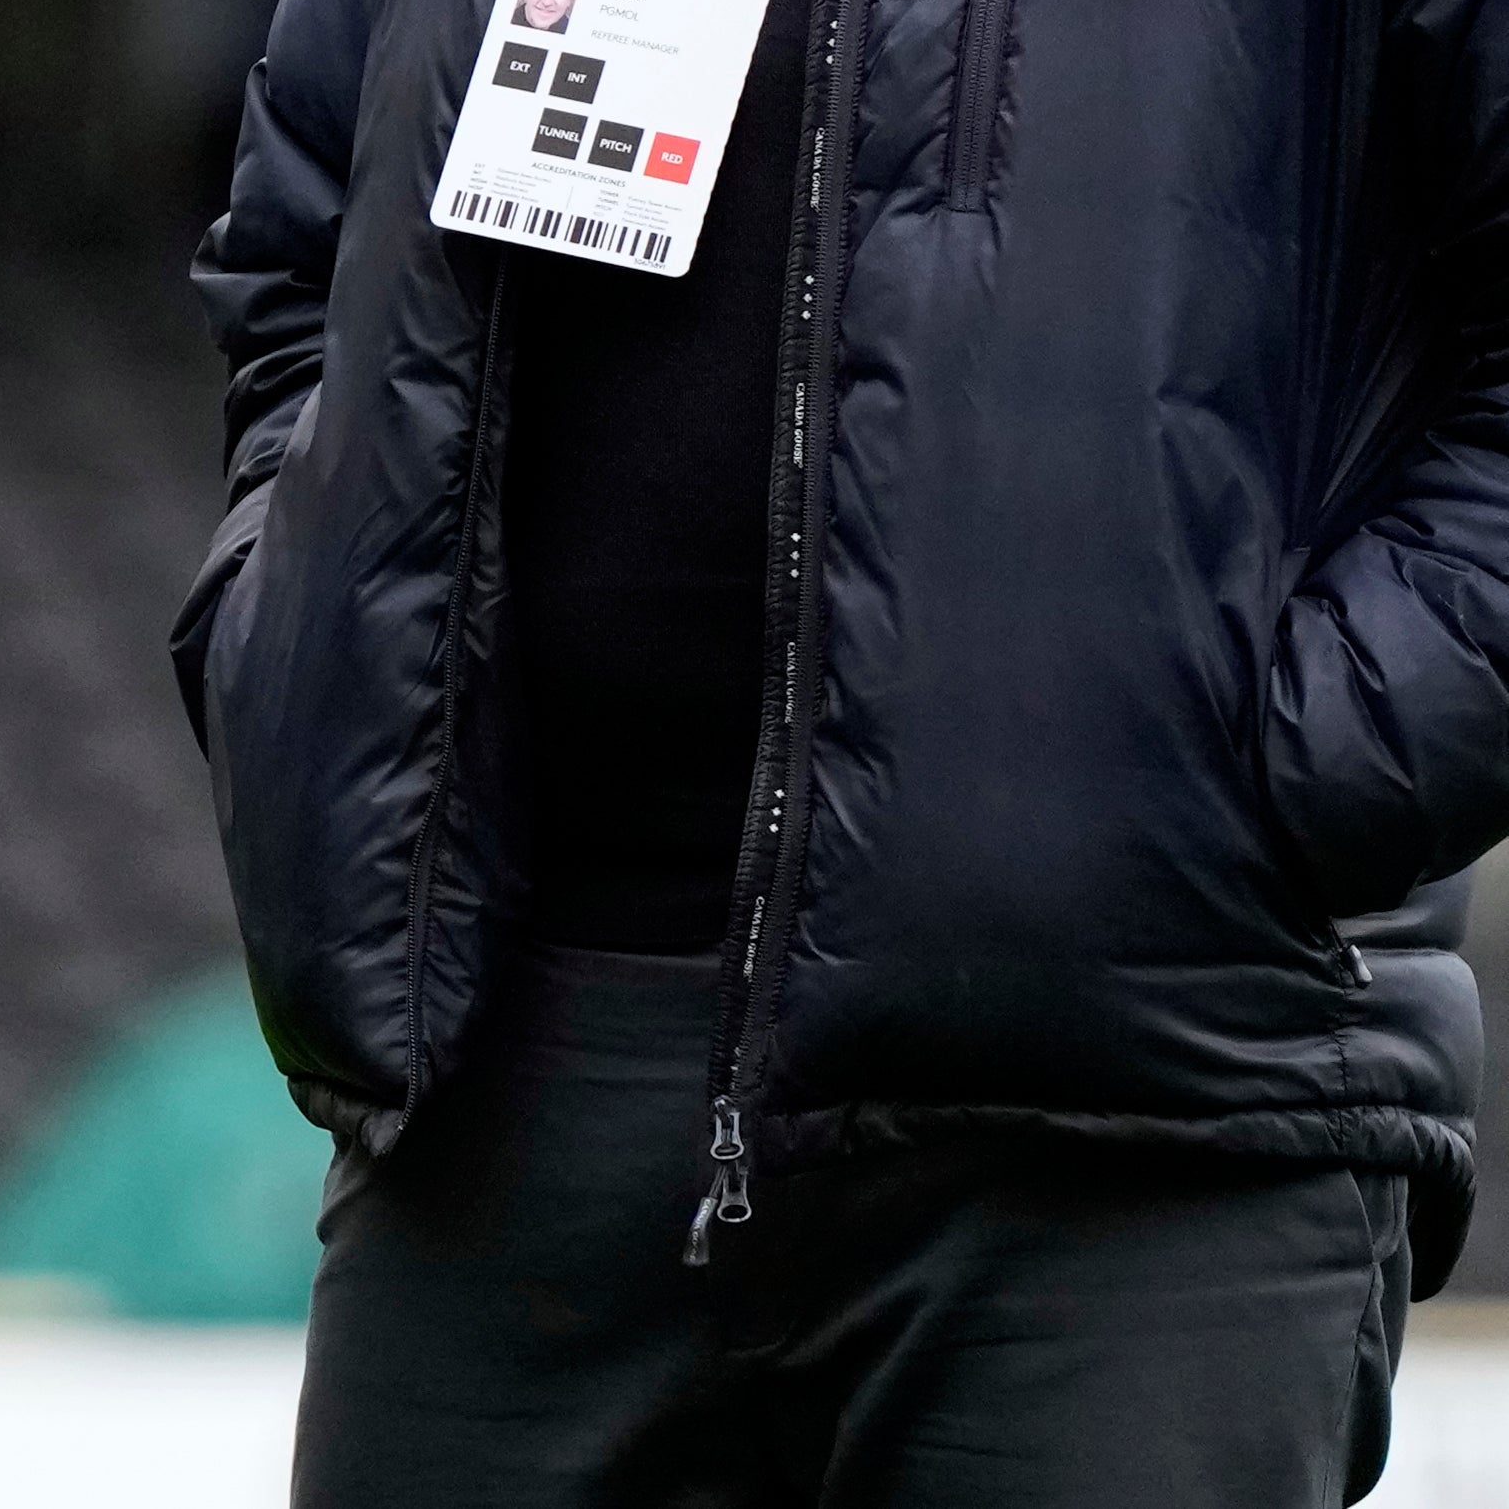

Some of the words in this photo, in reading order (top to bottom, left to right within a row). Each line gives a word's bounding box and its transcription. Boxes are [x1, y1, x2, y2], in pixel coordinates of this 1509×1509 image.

[599, 4, 639, 22] PGMOL
[509, 60, 531, 73] EXT
[567, 72, 587, 84] INT
[538, 124, 581, 143] TUNNEL
[599, 138, 633, 154] PITCH
[813, 127, 825, 170] CANADA
[661, 152, 683, 165] RED
[531, 162, 597, 181] ACCREDITATION
[598, 176, 627, 188] ZONES
[794, 382, 806, 426] CANADA
[749, 895, 765, 939] CANADA
